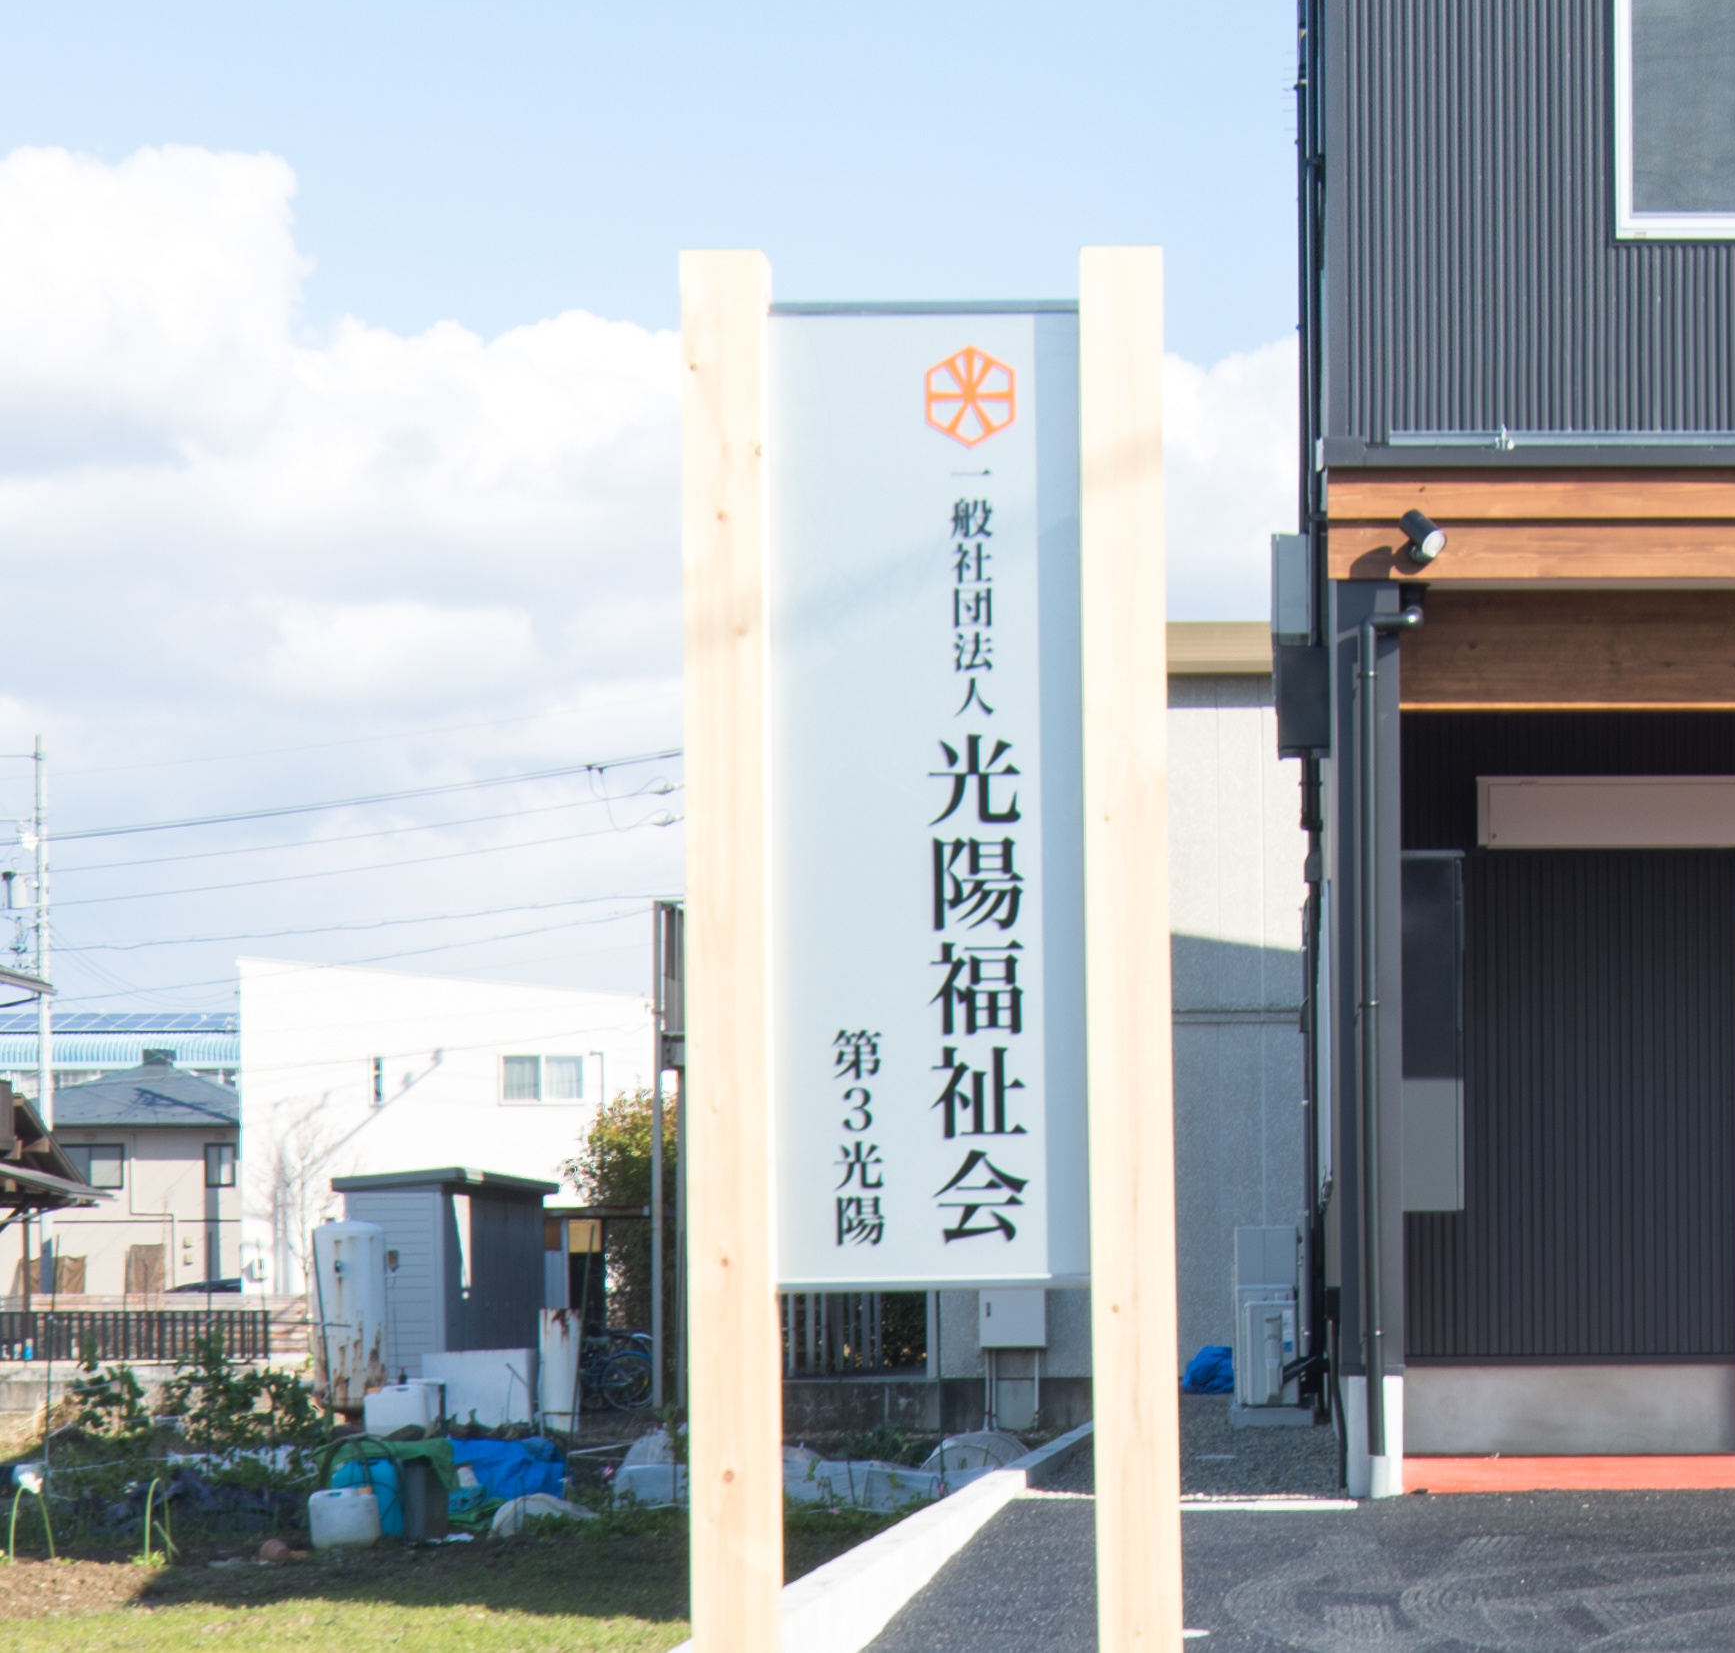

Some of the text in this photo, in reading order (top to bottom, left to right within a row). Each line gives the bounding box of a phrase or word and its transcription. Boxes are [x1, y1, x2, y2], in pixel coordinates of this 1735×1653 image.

[929, 467, 1028, 1244] 一般社団法人 光陽福祉会
